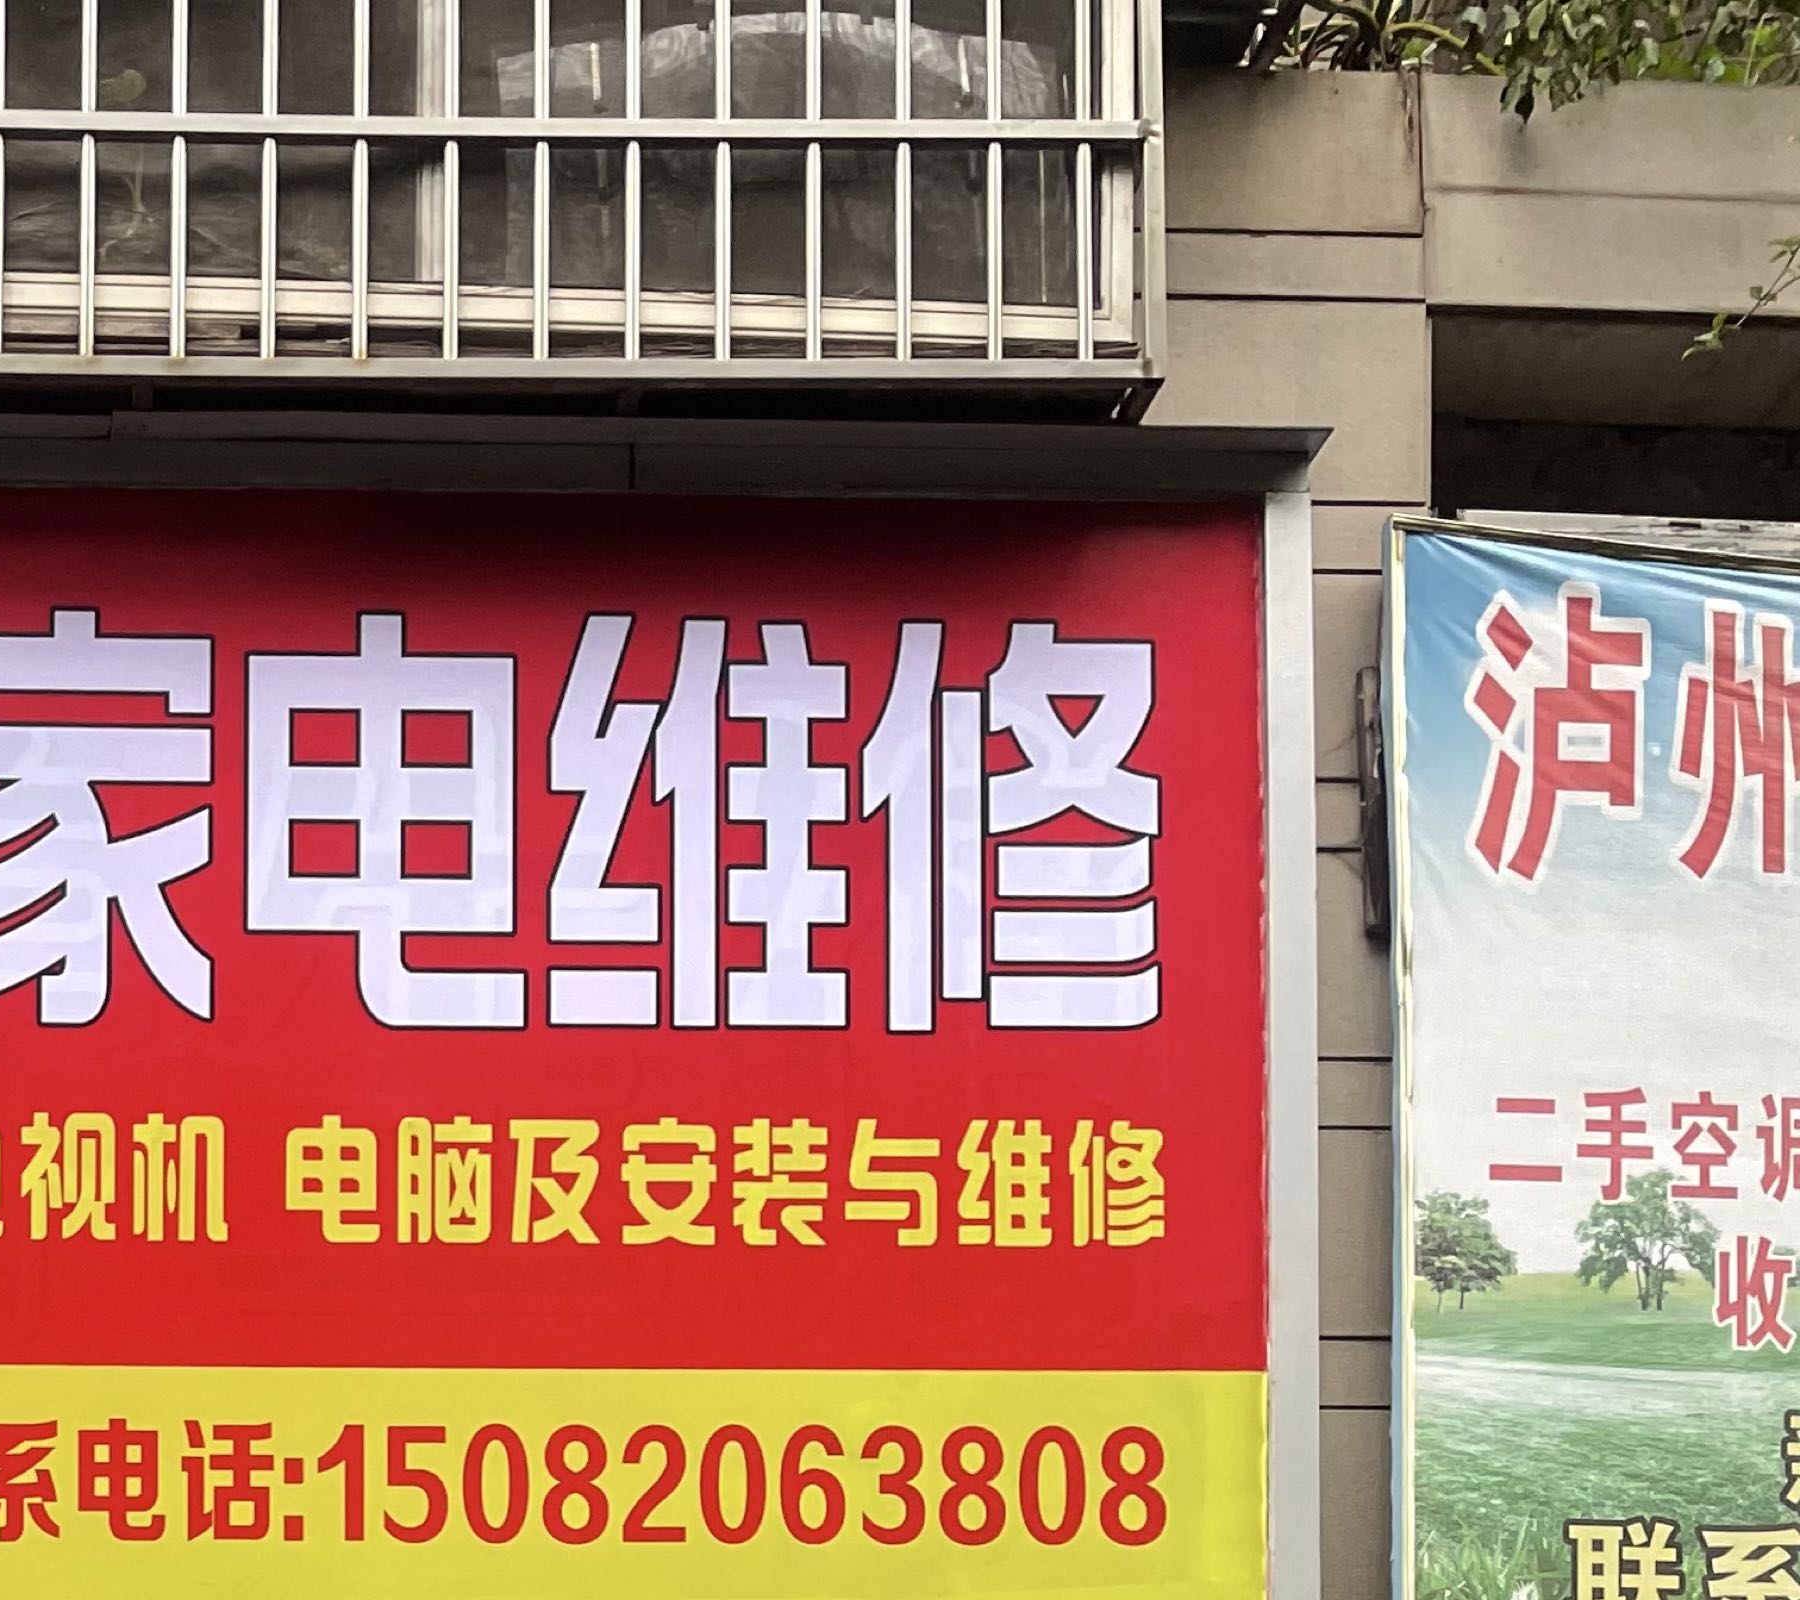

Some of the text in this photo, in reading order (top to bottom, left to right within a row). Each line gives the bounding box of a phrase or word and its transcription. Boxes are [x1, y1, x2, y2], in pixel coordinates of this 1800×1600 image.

[1472, 595, 1800, 880] 泸州
[284, 1113, 1167, 1250] 电脑及安装与维修
